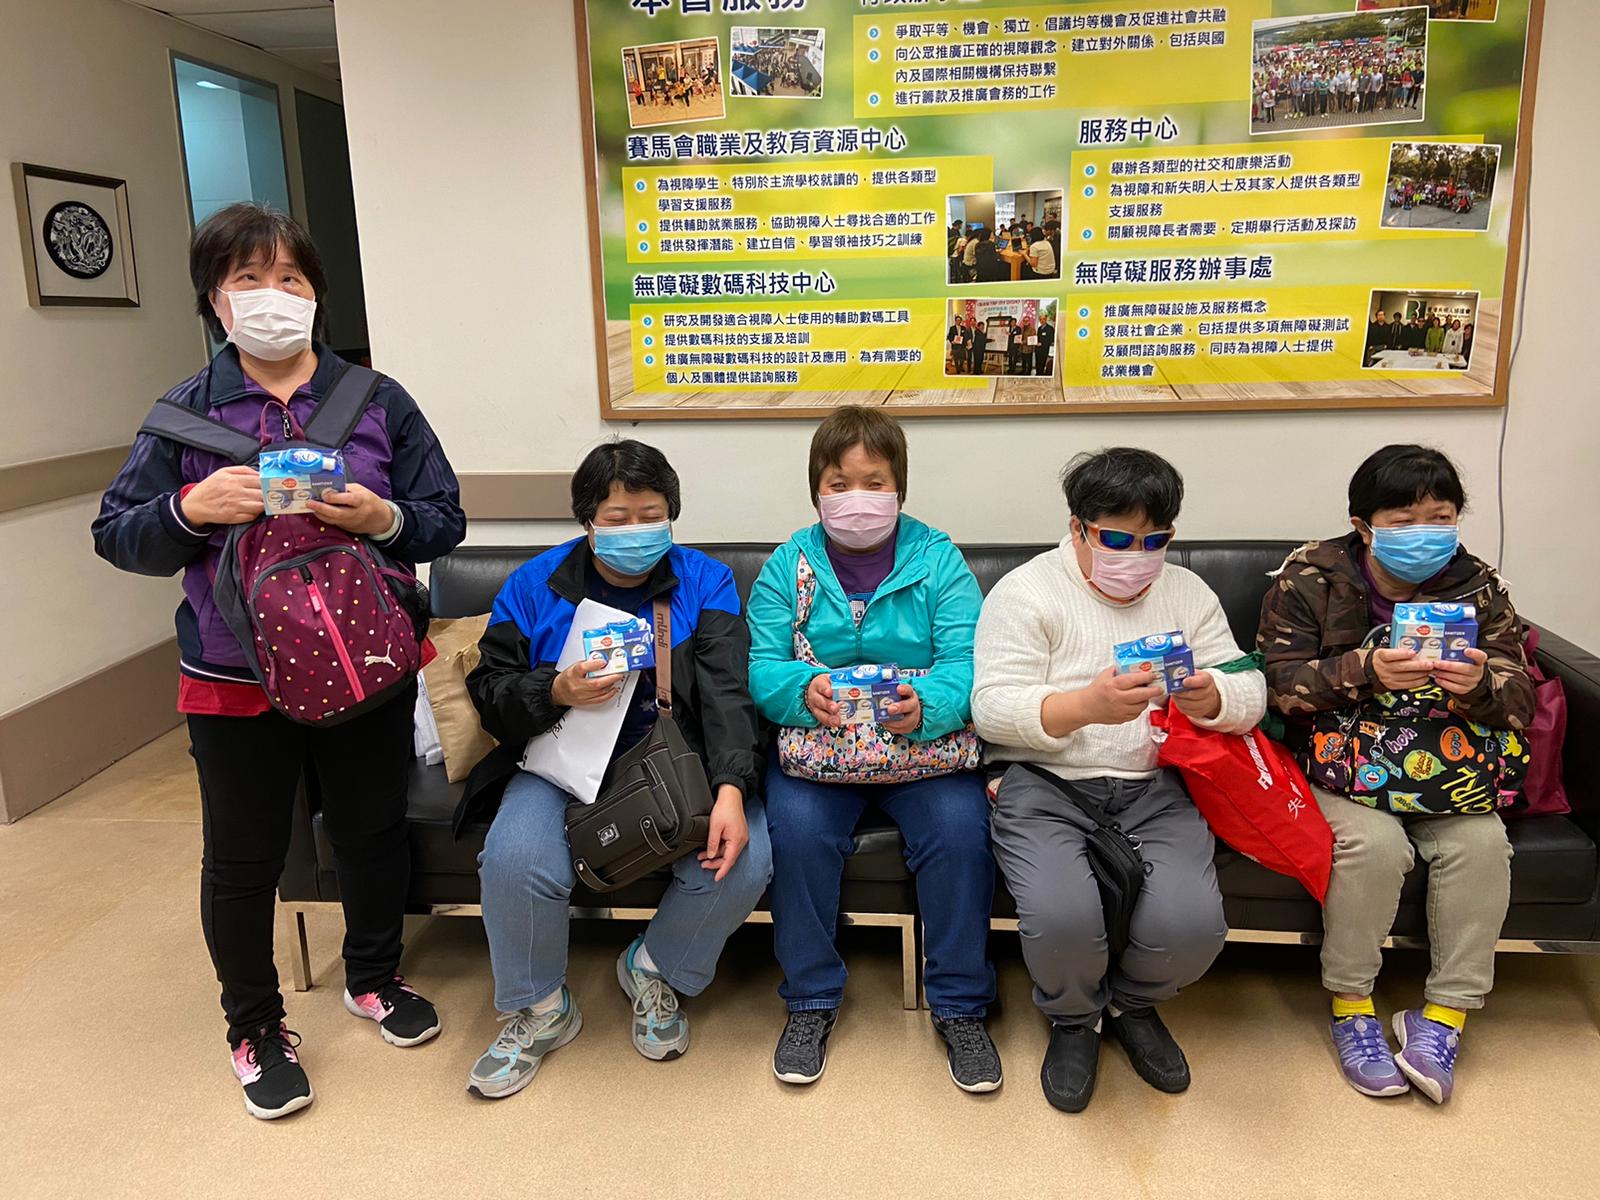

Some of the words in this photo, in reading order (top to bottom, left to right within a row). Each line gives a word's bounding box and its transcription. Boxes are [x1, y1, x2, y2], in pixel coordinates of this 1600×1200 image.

[896, 62, 1056, 82] 內及國際相關機構保持聯繫
[895, 85, 1055, 105] 進行籌款及推廣會務的工作
[1080, 117, 1177, 143] 服務中心
[627, 128, 905, 158] 賽馬會職業及教育資源中心
[1111, 155, 1291, 175] 舉辦各類型的社交和康樂活動
[1111, 173, 1360, 197] 為視障和新失明人士及其家人提供各類型
[659, 197, 732, 212] 學習支援服務
[1110, 203, 1163, 218] 支援服務
[1076, 256, 1272, 284] 無障礙服務辦事處
[635, 272, 835, 296] 無障礙數碼科技中心
[664, 310, 909, 327] 研究及開發適合視障人士使用的輔助數碼工具
[1104, 300, 1266, 318] 推廣無障礙設施及服務概念
[664, 332, 810, 346] 提供數碼科技的支援及培訓
[666, 370, 798, 384] 個人及團體提供諮詢服務
[1102, 364, 1154, 377] 就業機會
